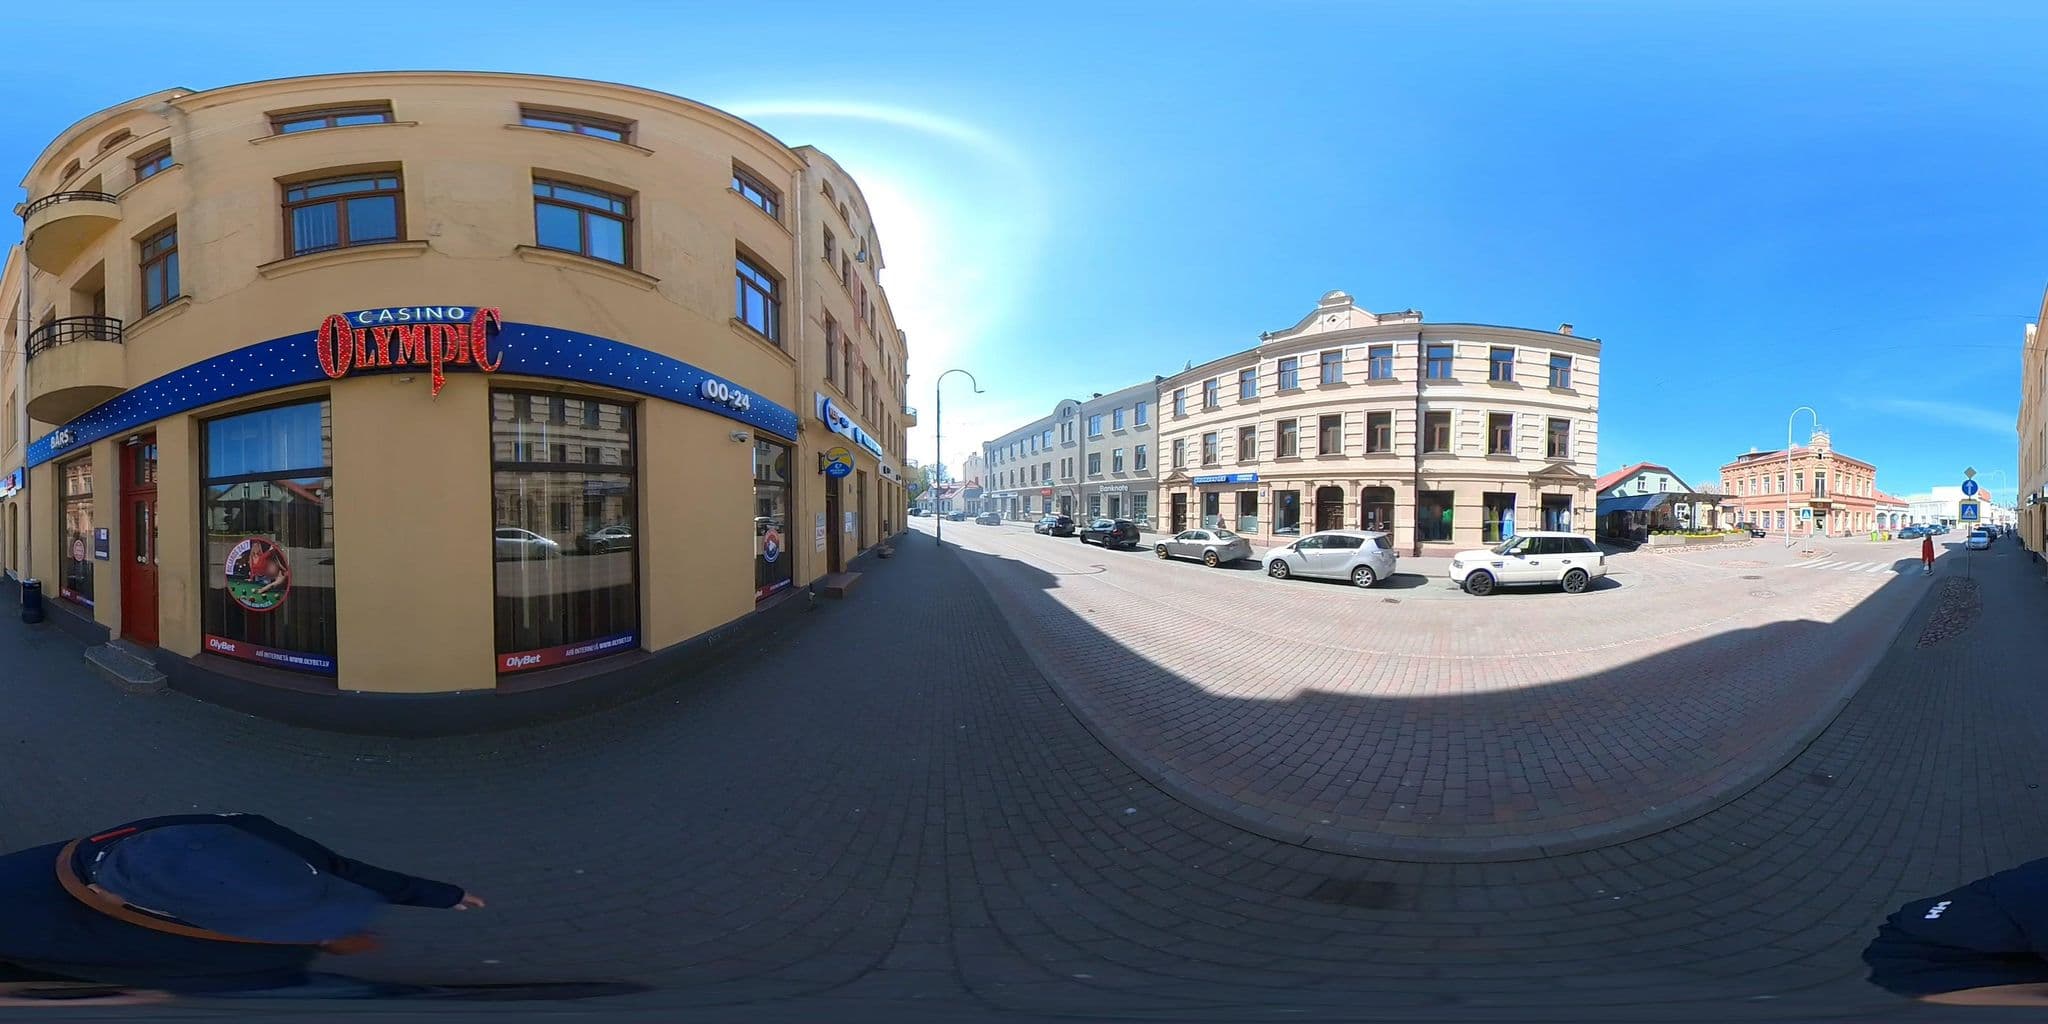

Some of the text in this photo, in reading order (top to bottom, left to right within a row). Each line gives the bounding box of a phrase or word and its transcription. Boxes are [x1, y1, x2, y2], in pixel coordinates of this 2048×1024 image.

[359, 307, 464, 324] CASINO
[317, 307, 503, 398] OLYMPIC
[707, 379, 750, 410] 00-24
[51, 429, 69, 449] BĀRS
[210, 639, 236, 652] OlyBet
[506, 654, 541, 667] OlyBet
